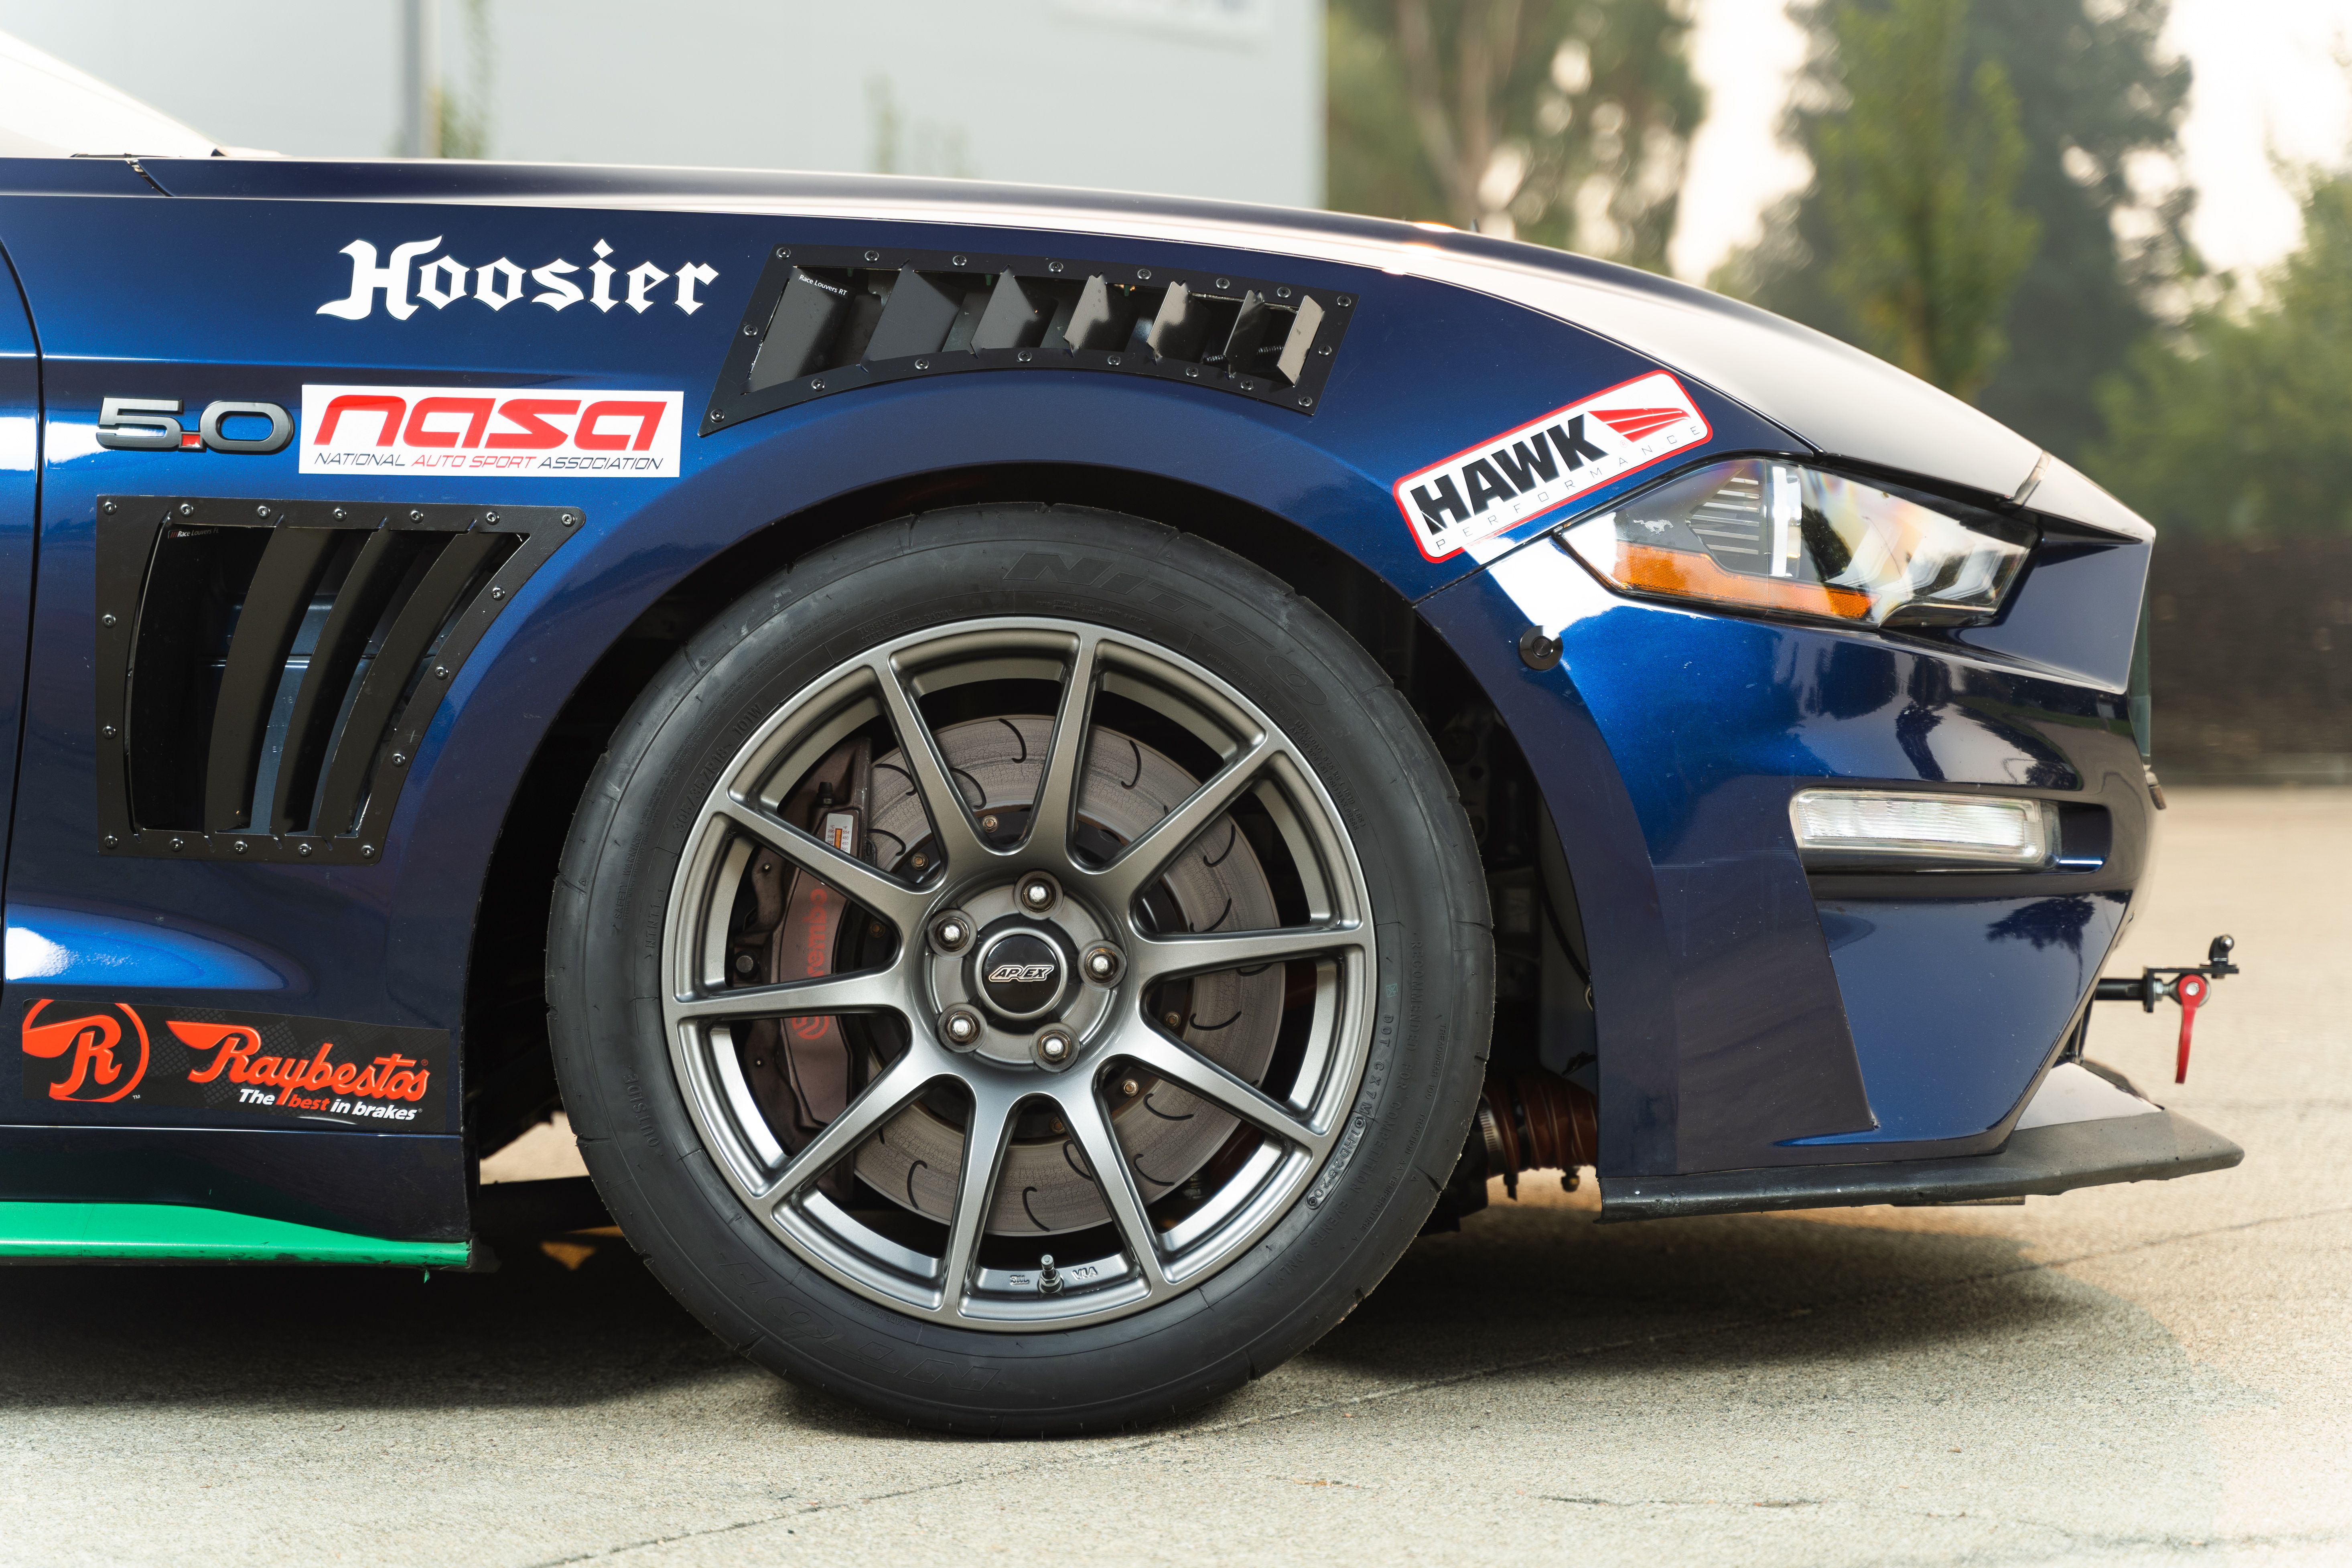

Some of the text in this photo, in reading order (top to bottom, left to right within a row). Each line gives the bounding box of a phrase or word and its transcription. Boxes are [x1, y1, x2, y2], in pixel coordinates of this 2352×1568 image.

[316, 235, 719, 321] Hoosier
[799, 274, 814, 284] Race
[814, 280, 838, 293] Louvers
[95, 397, 295, 454] 5.0
[315, 452, 664, 470] NATIONAL AUTO SPORT ASSOCIATION
[1410, 413, 1609, 536] HAWK
[1437, 426, 1700, 550] PERFORMANCE
[1003, 553, 1329, 705] NITTO
[613, 829, 644, 919] SAFETY WARNING:
[802, 888, 828, 977] rembo
[990, 966, 1051, 980] APEX
[1378, 1014, 1394, 1047] DOT
[1431, 1022, 1447, 1078] TREADWEAR
[165, 1020, 430, 1105] Raybestos
[1424, 1082, 1435, 1100] 100
[239, 1088, 418, 1120] The best in brakes
[622, 1071, 663, 1150] OUTSIDE
[1271, 941, 1424, 1284] RECOMMENDED FOR COMPETITION EVENTS ONLY
[1403, 1112, 1427, 1155] TRACTION
[1395, 1158, 1407, 1172] AA
[1358, 1173, 1400, 1233] TEMPERATURE
[849, 1298, 875, 1315] JAPAN
